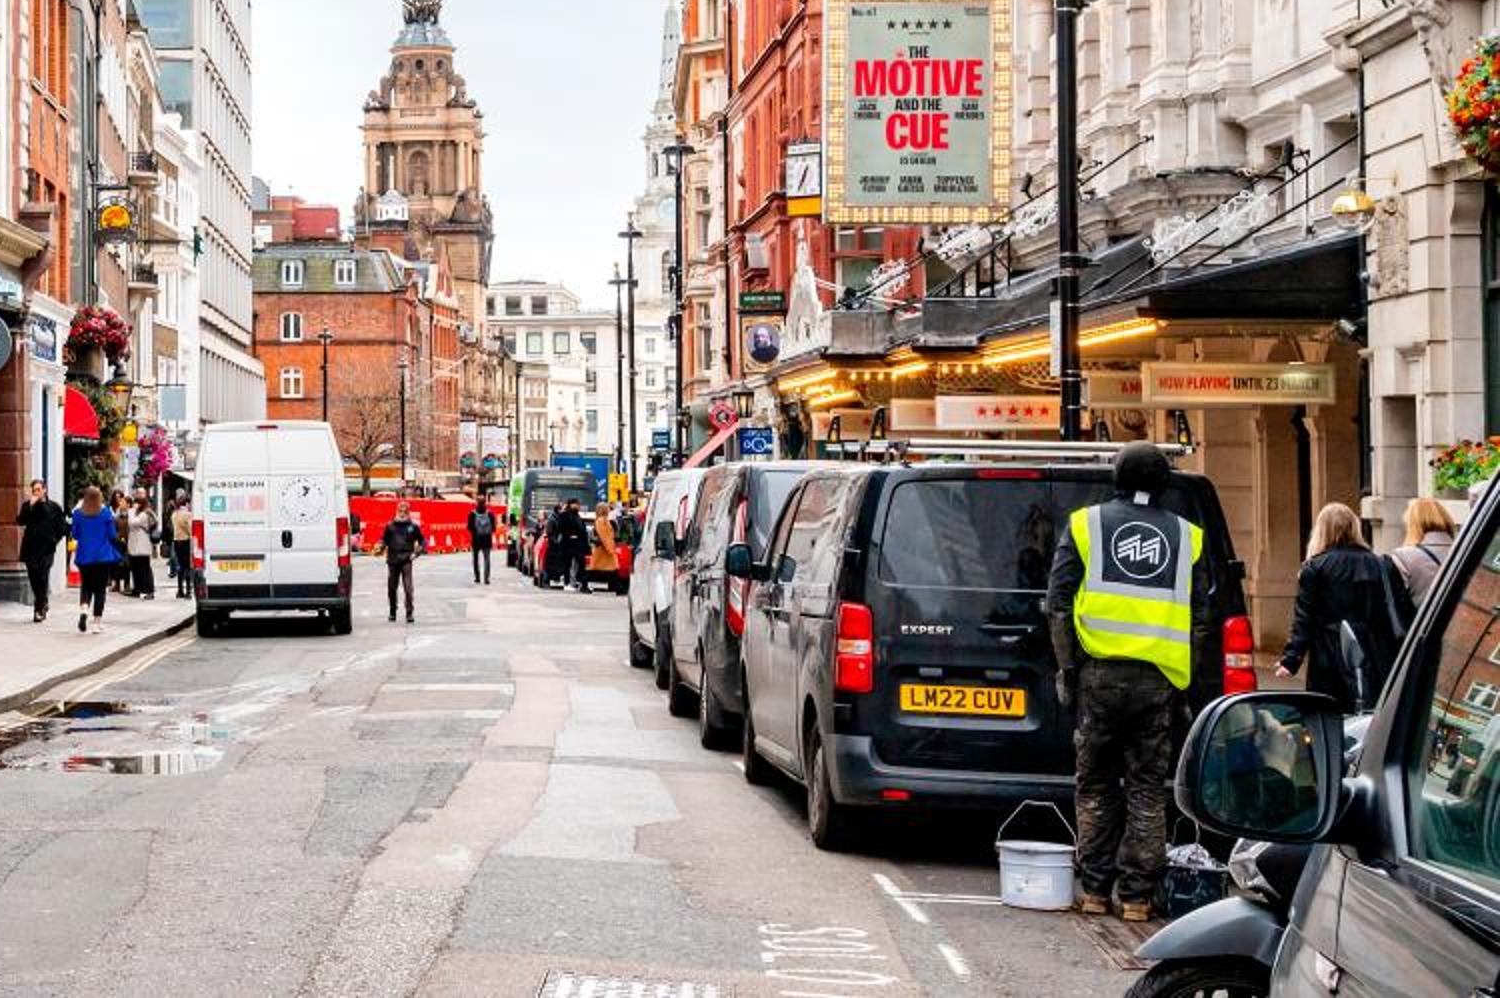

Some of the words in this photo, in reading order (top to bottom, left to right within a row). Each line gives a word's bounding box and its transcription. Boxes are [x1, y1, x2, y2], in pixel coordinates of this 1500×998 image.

[908, 45, 931, 59] THE
[854, 59, 984, 96] MOTIVE
[895, 99, 919, 111] AND
[921, 98, 943, 111] THE
[885, 113, 949, 150] CUE
[1158, 377, 1183, 390] NOW
[1187, 377, 1231, 390] PLAYING
[1233, 377, 1264, 390] UNTIL
[1265, 377, 1279, 391] 23
[901, 624, 954, 635] EXPERT
[910, 687, 967, 709] LM22
[973, 690, 1015, 710] CUV
